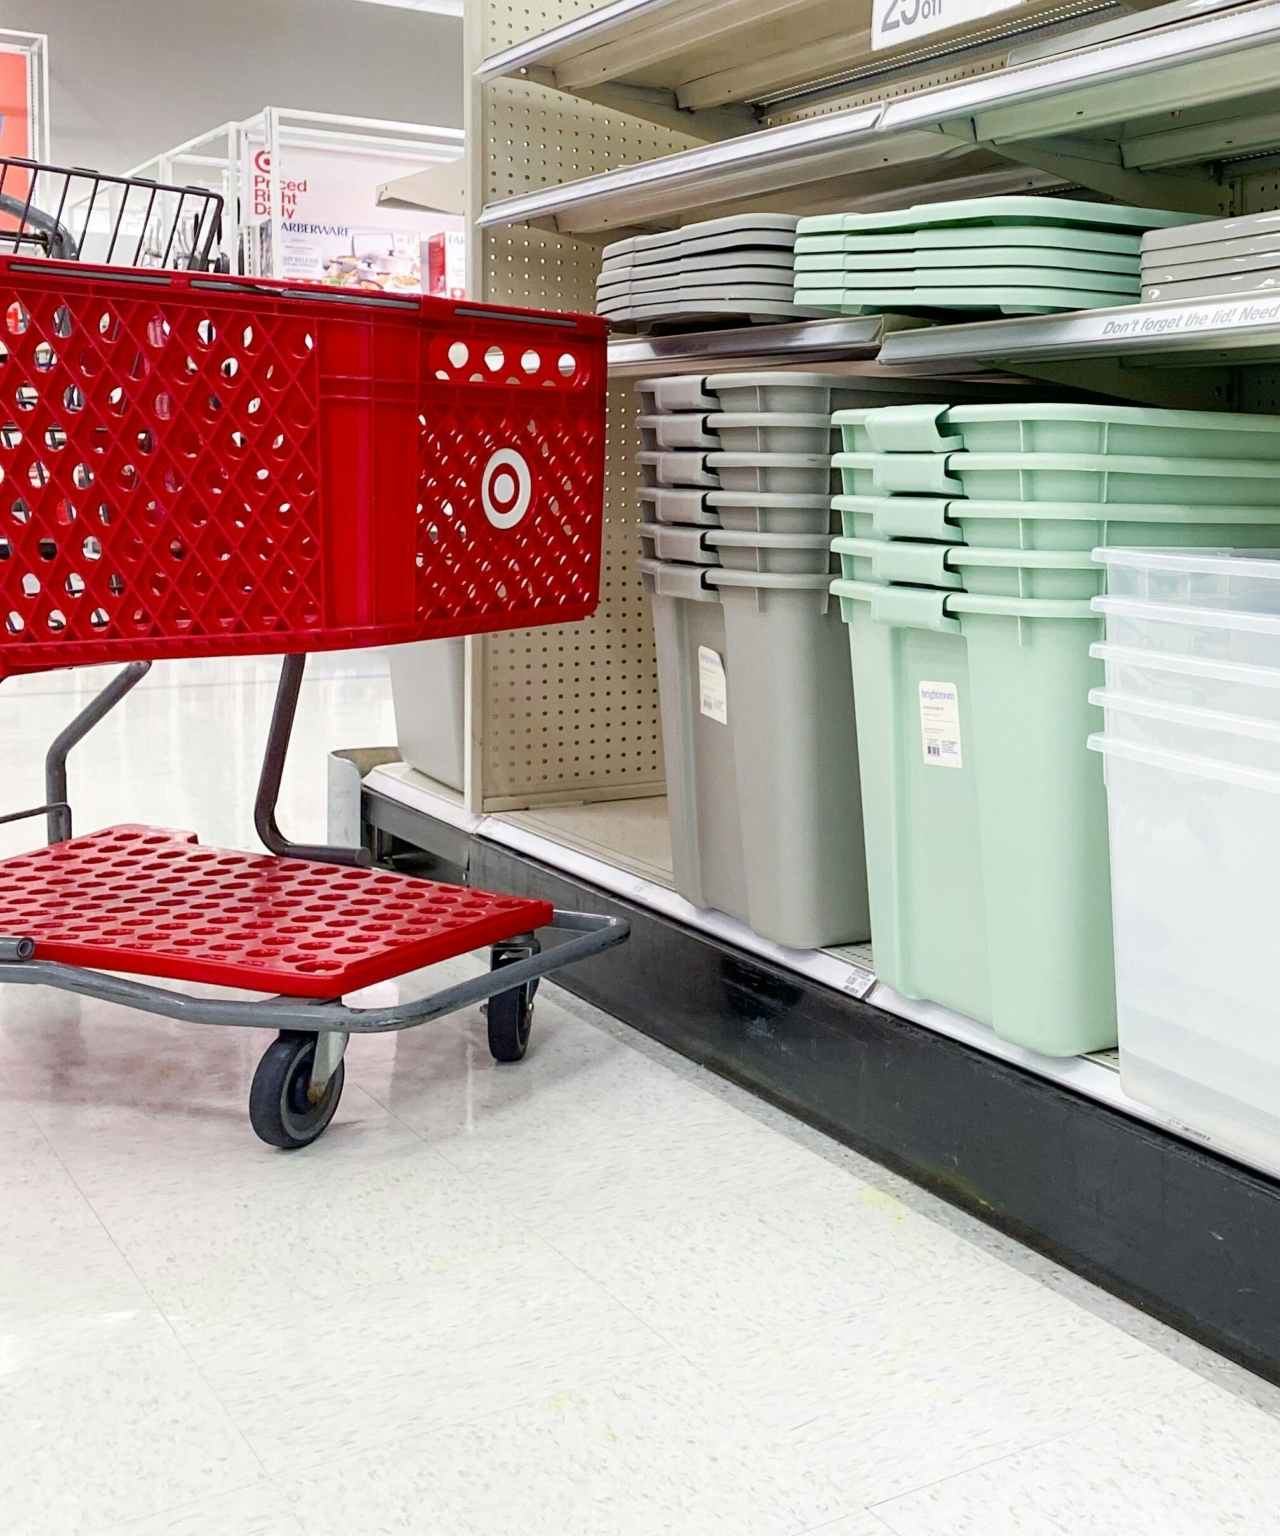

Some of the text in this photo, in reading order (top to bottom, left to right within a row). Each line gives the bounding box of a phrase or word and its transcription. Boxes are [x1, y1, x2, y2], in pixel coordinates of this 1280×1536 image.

[254, 175, 307, 193] Prced
[254, 189, 297, 205] Riht
[254, 203, 295, 219] Daly
[1102, 319, 1139, 336] Don't
[1140, 314, 1183, 333] forget
[1185, 312, 1208, 328] the
[1210, 308, 1235, 326] lid!
[1238, 305, 1279, 322] Need
